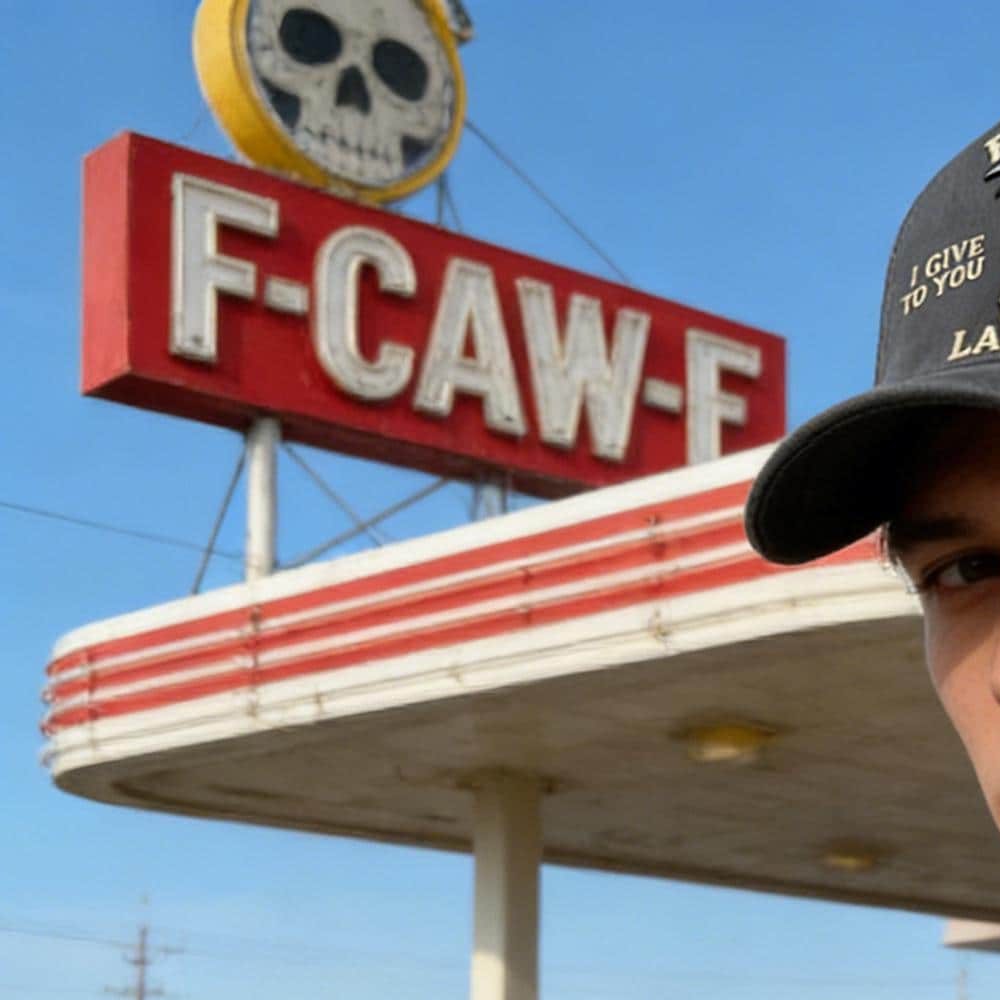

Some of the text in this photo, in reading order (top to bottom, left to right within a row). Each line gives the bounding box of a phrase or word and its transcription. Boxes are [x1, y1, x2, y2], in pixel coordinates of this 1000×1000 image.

[900, 256, 985, 316] TO YOU
[910, 234, 986, 289] I GIVE
[169, 173, 762, 467] F-CAW-F
